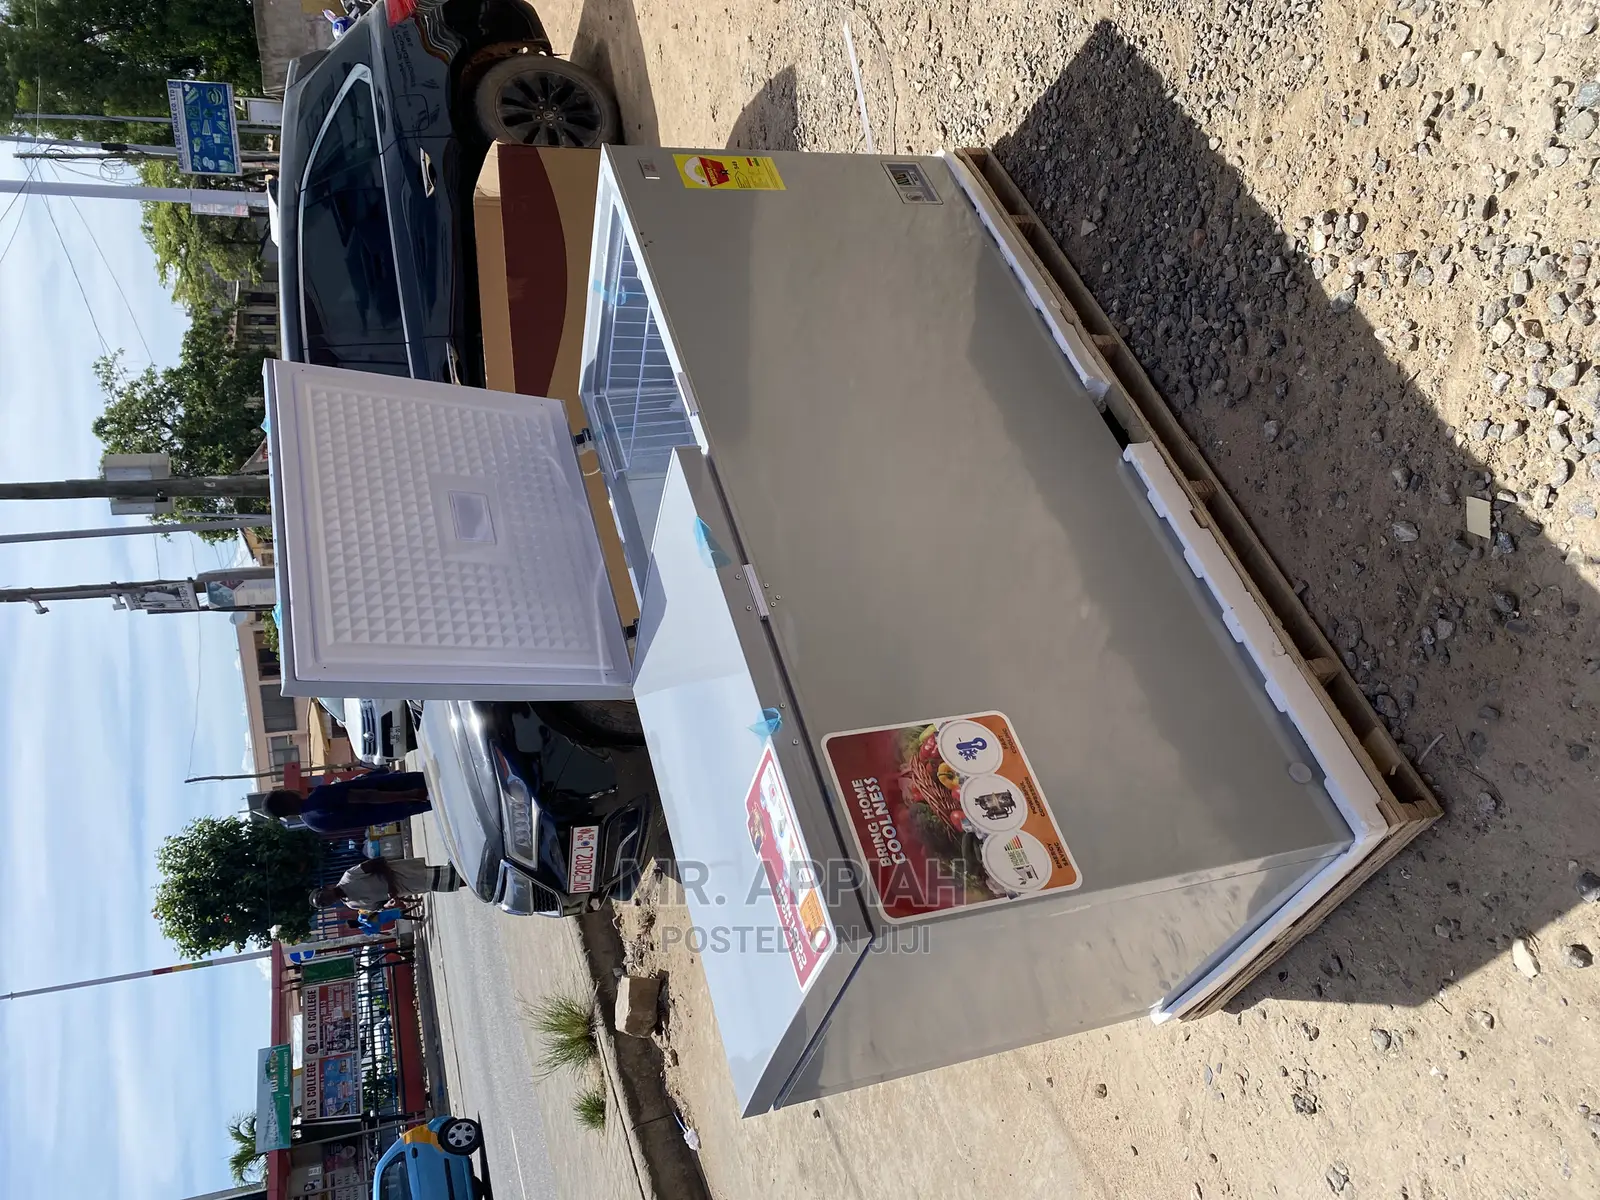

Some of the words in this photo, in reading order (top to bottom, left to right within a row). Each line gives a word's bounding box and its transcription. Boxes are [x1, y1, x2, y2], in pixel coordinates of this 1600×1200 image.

[172, 113, 180, 132] GHANA
[998, 735, 1008, 750] FAST
[1002, 728, 1017, 754] COOLING
[851, 779, 876, 819] HOME
[1020, 780, 1037, 814] POWERFUL
[1024, 776, 1045, 817] COMPRESSOR
[864, 777, 906, 865] COOLNESS
[868, 822, 892, 867] BRING
[1046, 842, 1063, 869] ENERGY
[1054, 842, 1069, 866] SAVING
[574, 853, 593, 875] 2802
[573, 882, 590, 891] DV
[778, 879, 807, 966] COOLNESS
[307, 990, 316, 1021] COLLEGE
[306, 1062, 316, 1098] COLLEGE
